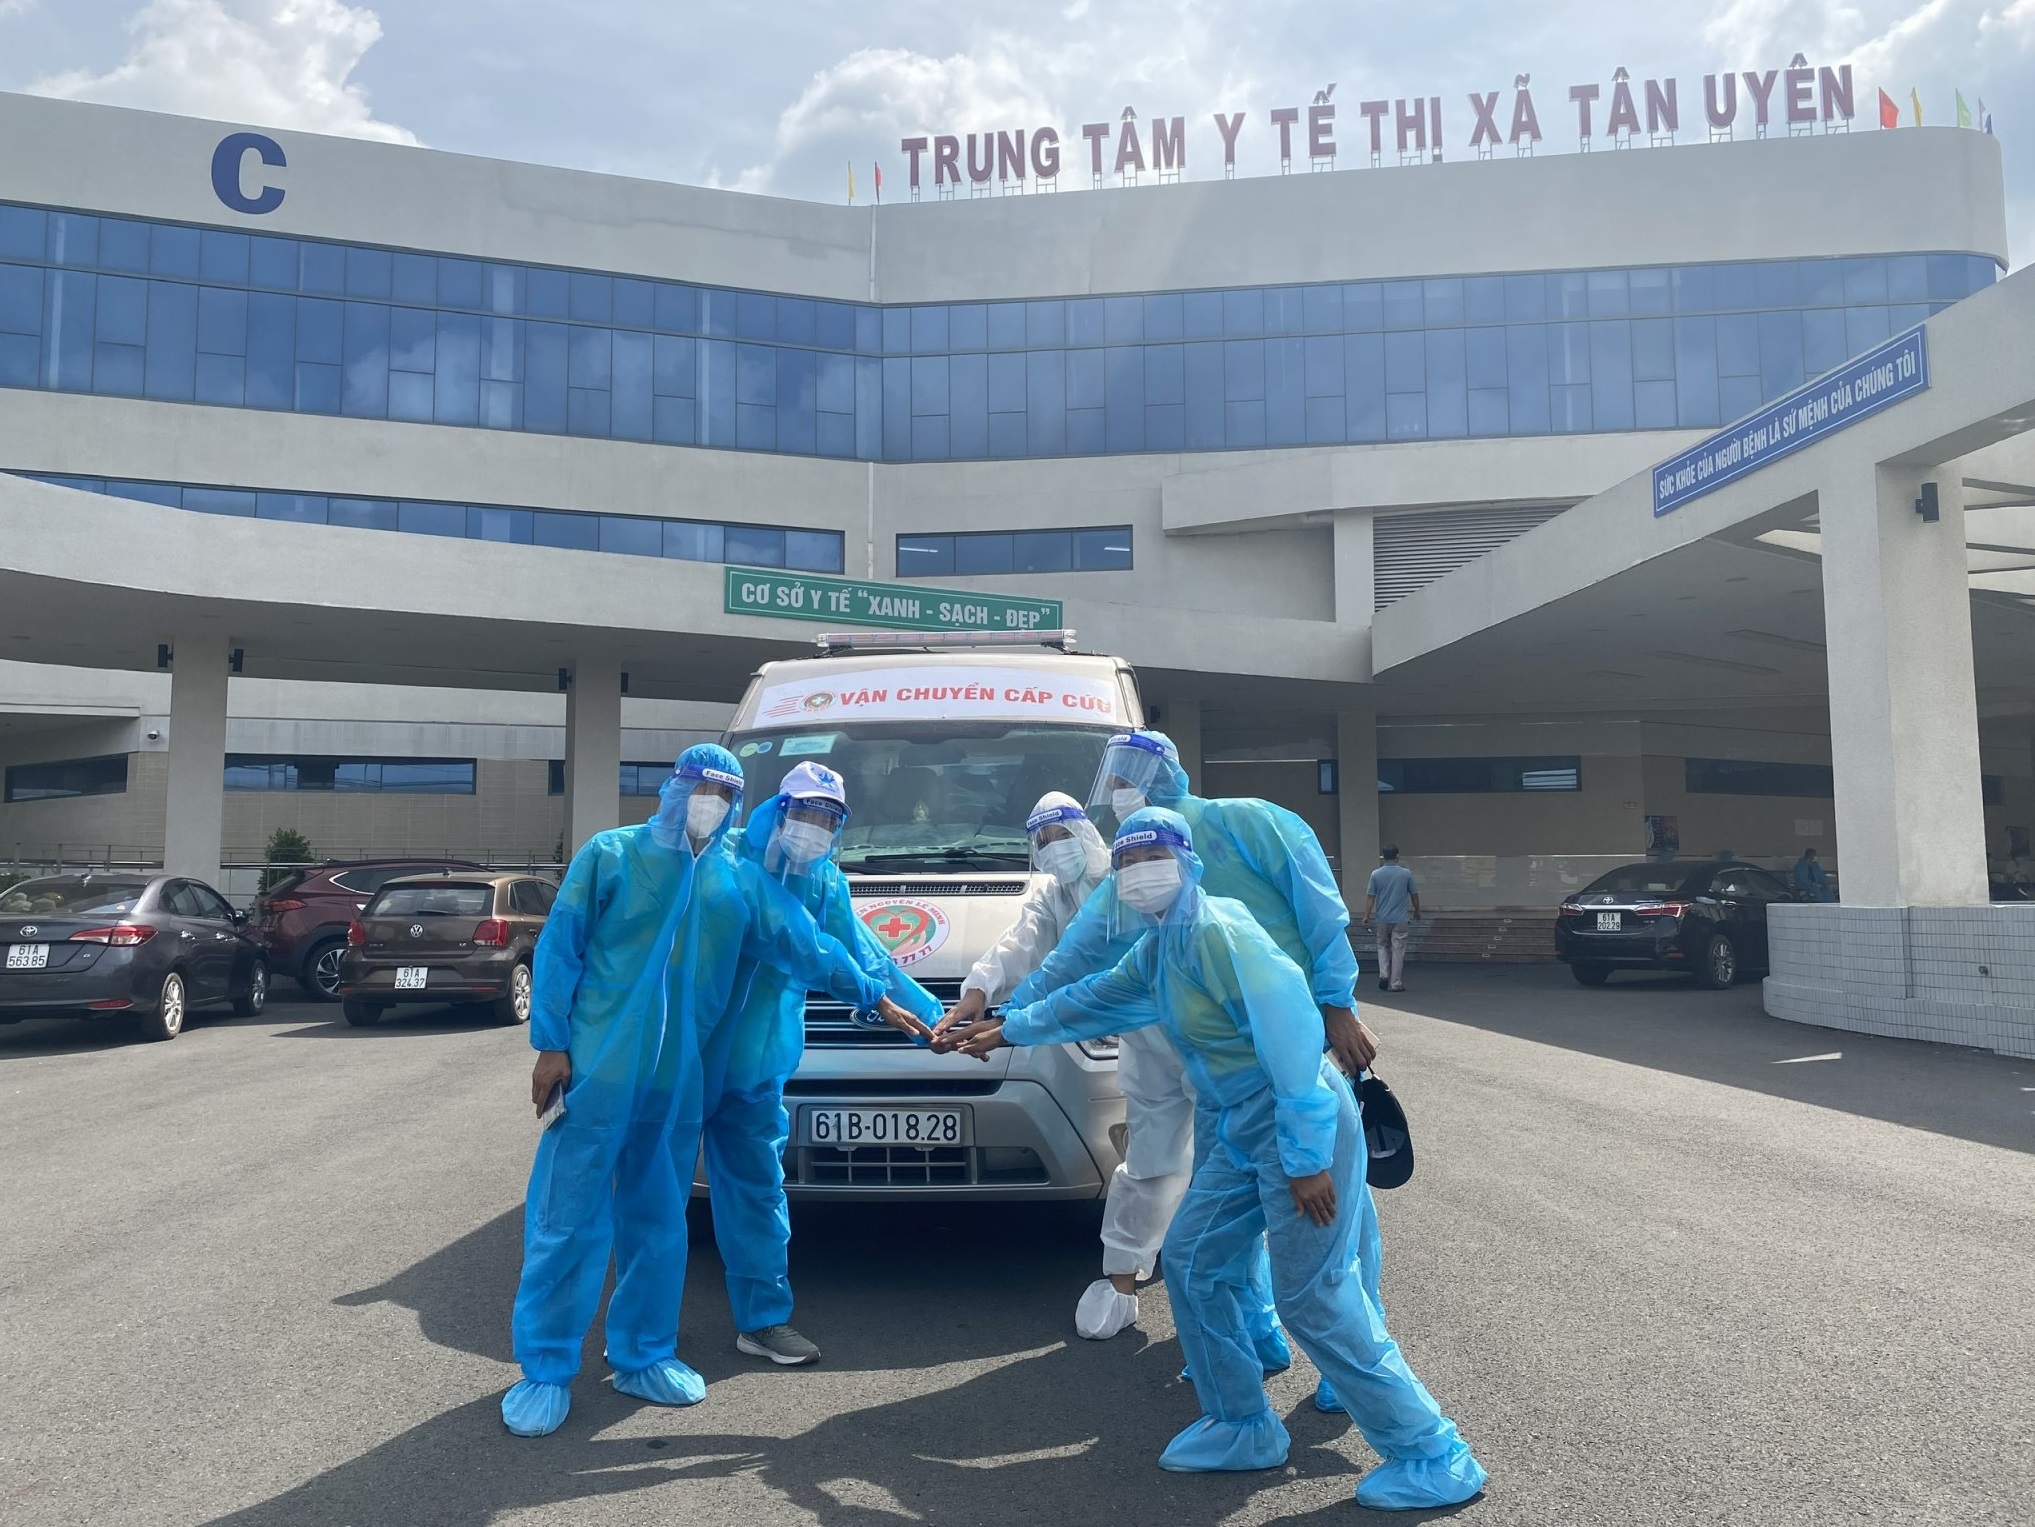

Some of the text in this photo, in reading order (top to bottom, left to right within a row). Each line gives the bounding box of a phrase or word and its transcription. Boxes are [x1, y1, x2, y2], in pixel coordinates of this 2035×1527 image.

[901, 52, 1855, 187] TRUNG TÂM Y TẾ THỊ XÃ TÂN UYÊN
[211, 132, 287, 215] C
[1659, 349, 1916, 499] SỨC KHỎE CỦA NGƯỜI BỆNH LÀ SỨ MỆNH CỦA CHÚNG TÔI
[741, 583, 770, 604] CƠ
[776, 581, 805, 608] SỞ
[810, 589, 822, 609] Y
[828, 587, 853, 612] TẾ
[939, 602, 988, 626] SẠCH
[840, 688, 887, 707] VẬN
[896, 682, 994, 701] CHUYỂN
[1004, 686, 1053, 704] CẤP
[706, 770, 724, 779] Face
[1125, 832, 1153, 843] Shield
[1602, 913, 1616, 921] 61A
[18, 944, 39, 955] 61A
[8, 955, 46, 967] 563.85
[403, 968, 420, 978] 61A
[396, 978, 425, 988] 324.37
[815, 1112, 957, 1142] 61B-018.28
